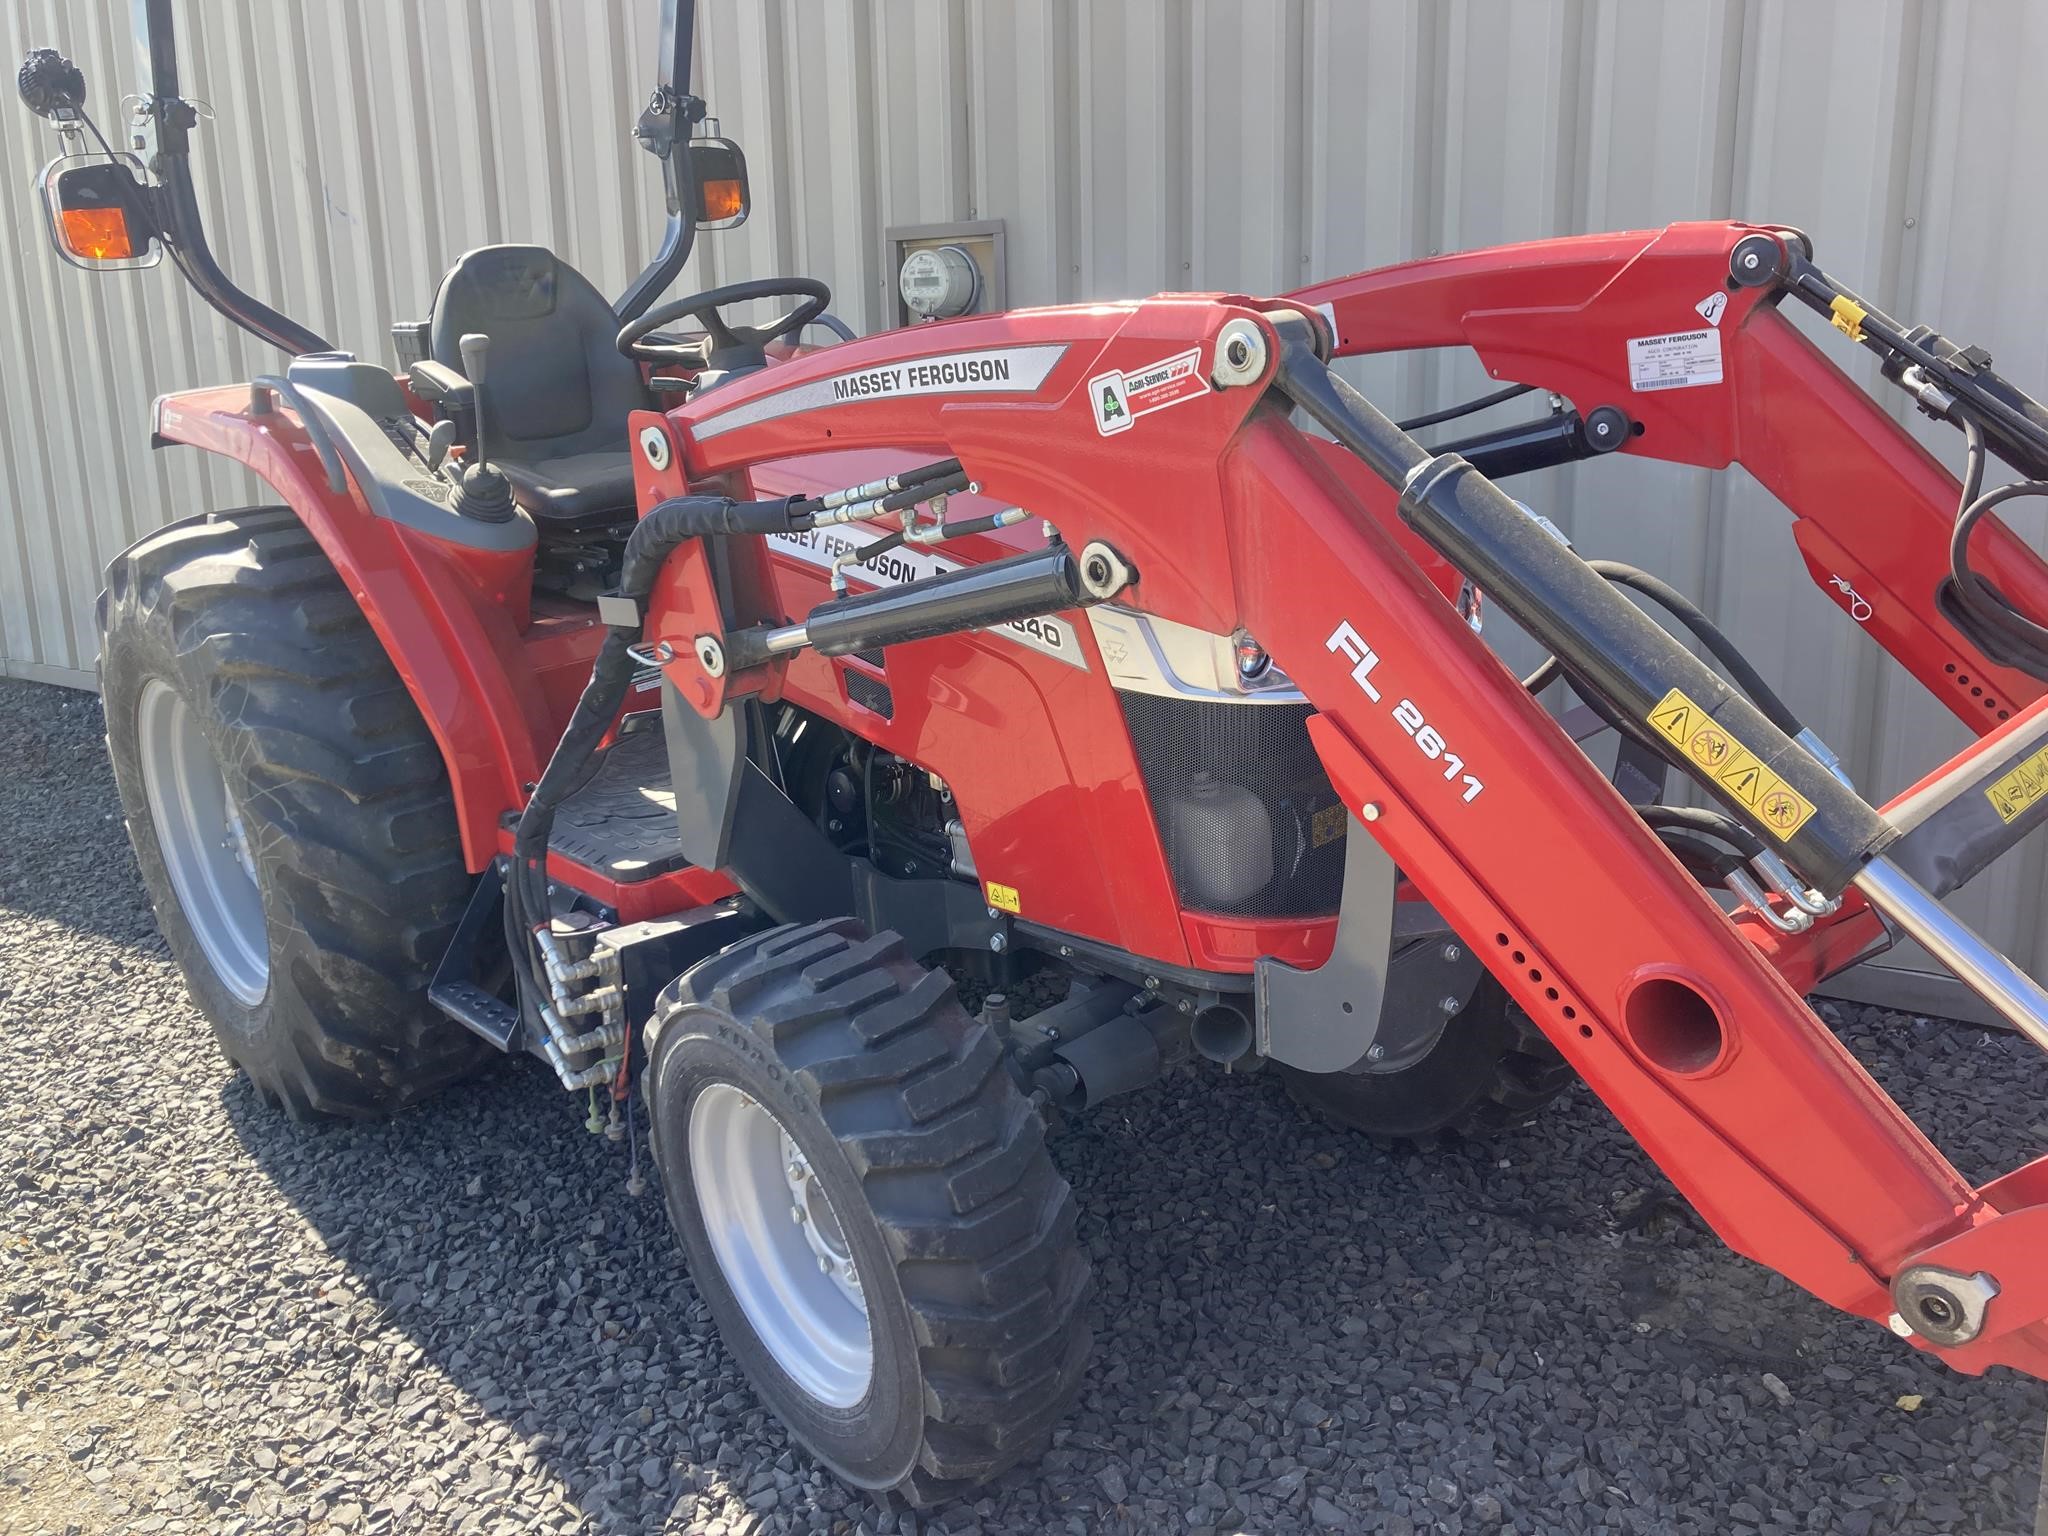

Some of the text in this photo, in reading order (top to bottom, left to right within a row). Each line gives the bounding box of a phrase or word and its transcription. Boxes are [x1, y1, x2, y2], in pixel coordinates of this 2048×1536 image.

[1638, 332, 1708, 347] MASSEY FERGUSON
[833, 359, 1010, 400] MASSEY FERGUSON
[767, 530, 916, 583] SEY FERUSON
[1006, 619, 1060, 647] 40
[1325, 619, 1485, 803] FL 2611
